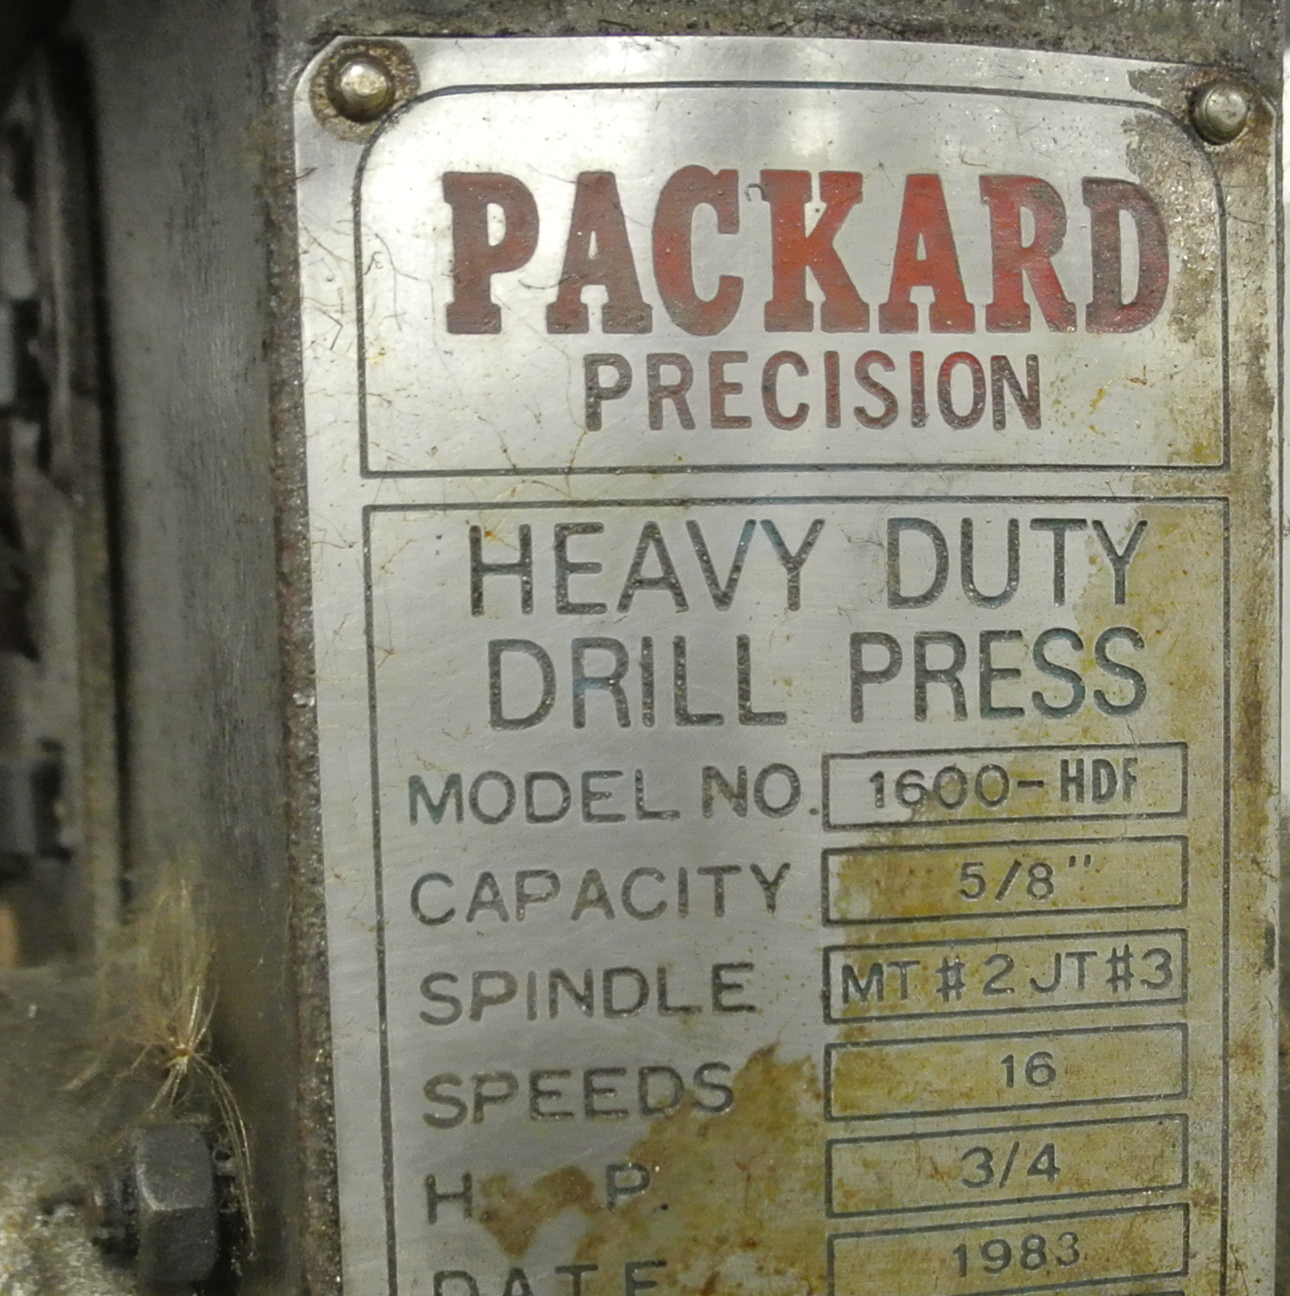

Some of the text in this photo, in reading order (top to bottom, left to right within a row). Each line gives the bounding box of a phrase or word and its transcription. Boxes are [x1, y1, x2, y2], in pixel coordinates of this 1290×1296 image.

[441, 164, 1172, 336] PACKARD
[583, 350, 1042, 432] PRECISION
[467, 517, 1148, 616] HEAVY DUTY
[488, 627, 1148, 731] DRILL PRESS
[408, 762, 820, 825] MODEL NO.
[869, 757, 1138, 811] 1600-HDF
[410, 862, 791, 927] CAPACITY
[959, 854, 1092, 902] 5/8"
[419, 963, 756, 1025] SPINDLE
[423, 1061, 736, 1127] SPEEDS
[1002, 1051, 1056, 1088] 16
[961, 1141, 1061, 1189] 3/4
[955, 1233, 1082, 1278] 1983
